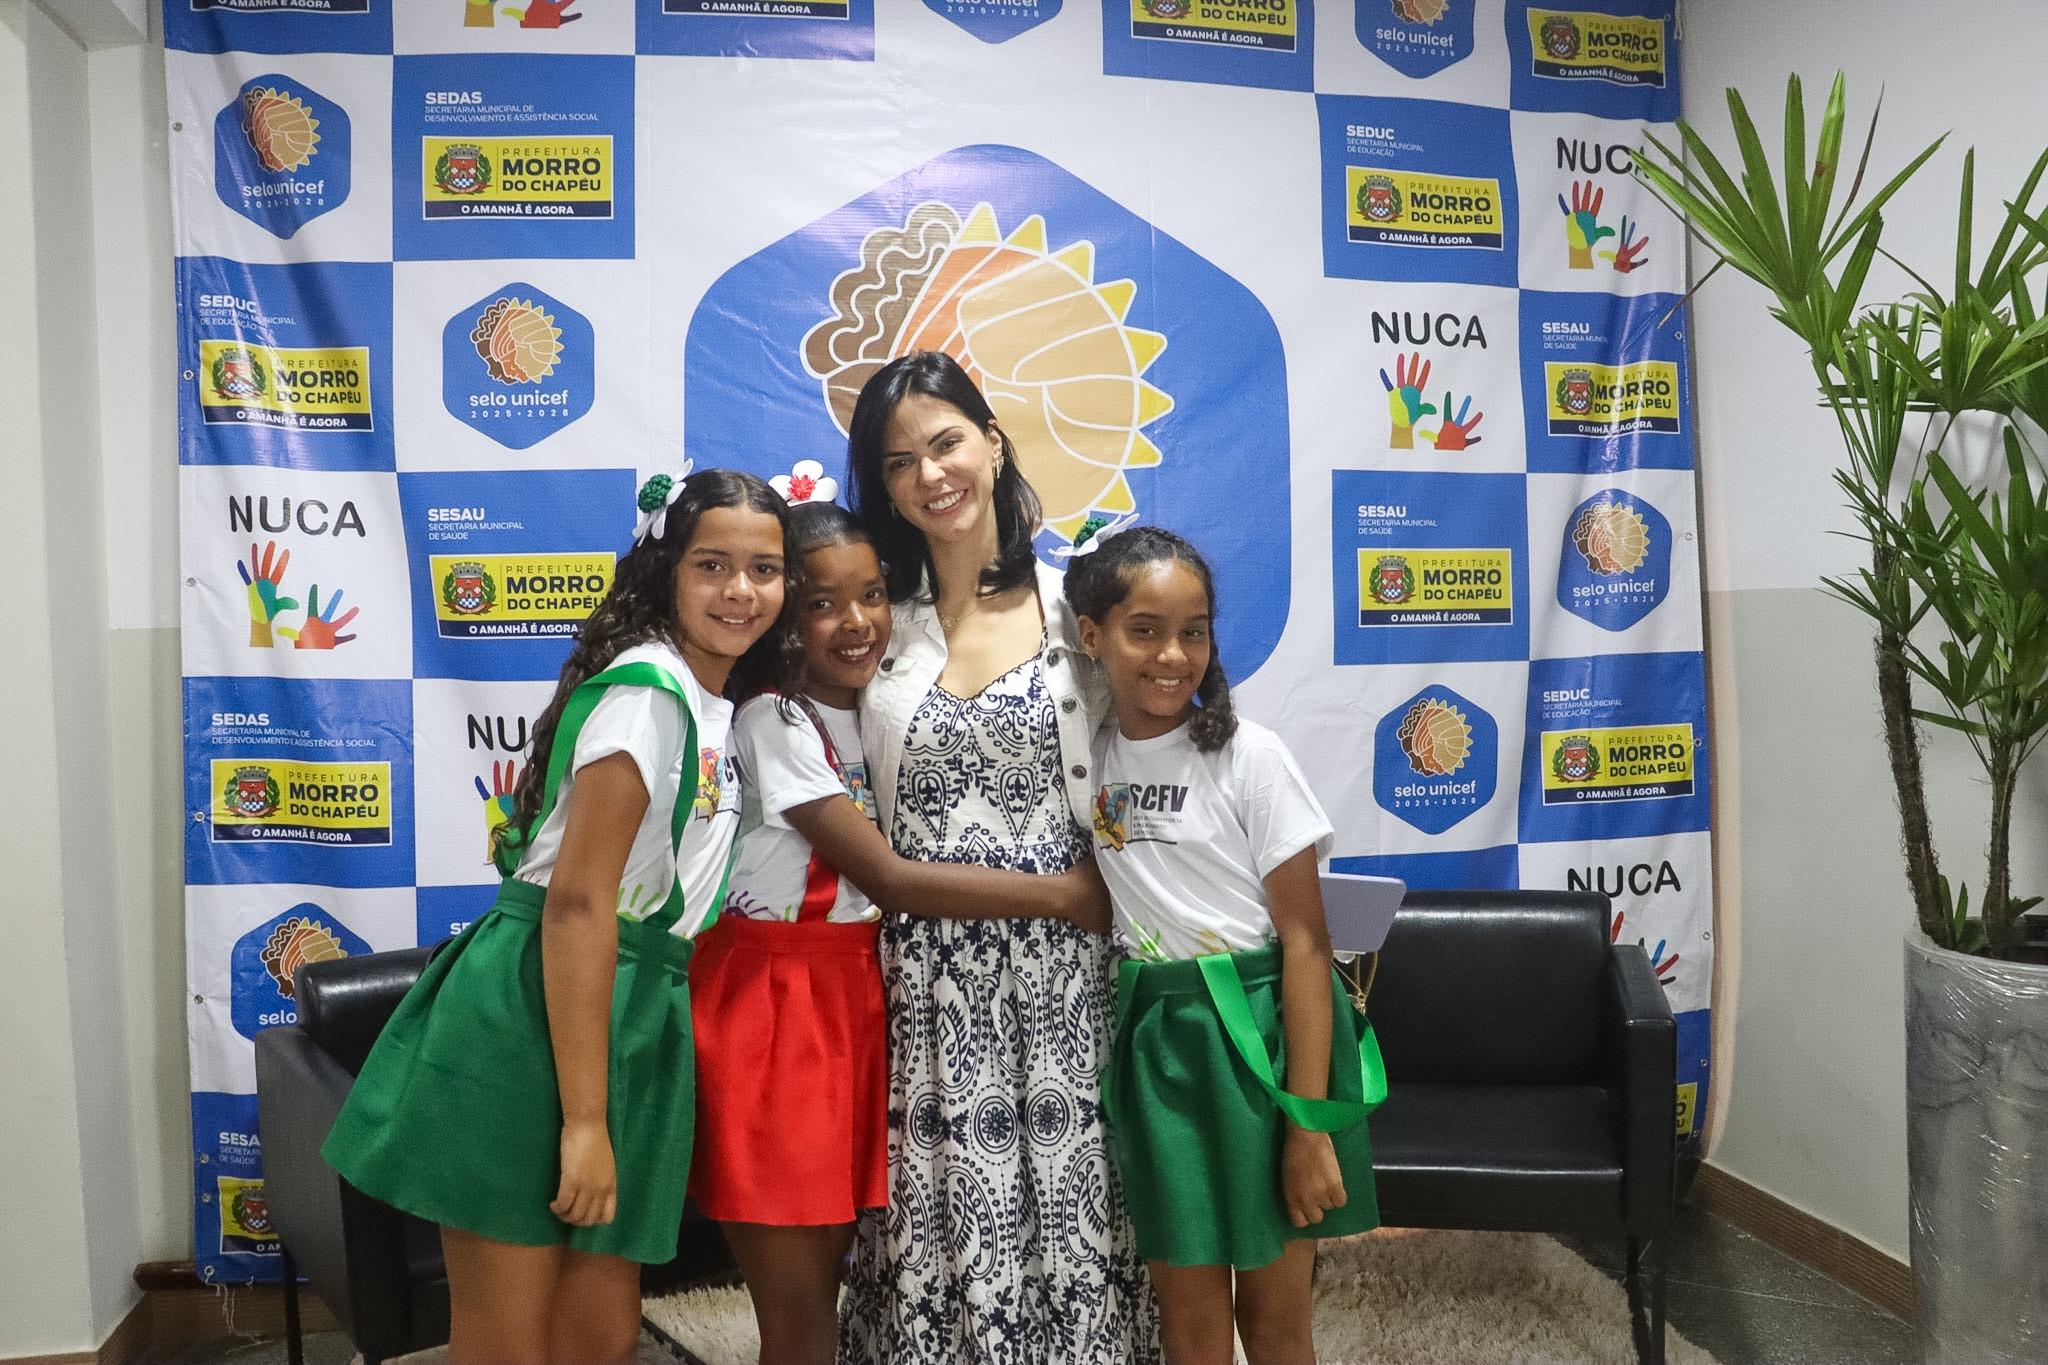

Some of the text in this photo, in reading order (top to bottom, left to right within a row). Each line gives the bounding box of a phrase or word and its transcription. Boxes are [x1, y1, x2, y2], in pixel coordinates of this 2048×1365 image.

[701, 2, 810, 14] O AMANHÃ É AGORA
[1202, 8, 1286, 25] DO CHAPÉU
[1166, 28, 1263, 45] O AMANHÃ É AGORA
[1376, 27, 1453, 47] selo unicef
[1588, 32, 1657, 51] MORRO
[1589, 49, 1608, 58] DO
[425, 91, 482, 104] SEDAS
[425, 114, 506, 122] DESENVOLVIMENTO
[514, 112, 567, 121] ASSISTÊNCIA
[569, 113, 599, 121] SOCIAL
[1346, 125, 1395, 139] SEDUC
[503, 147, 601, 157] PREFEITURA
[1346, 138, 1424, 152] SECRETARIA MUNICIPAL
[503, 158, 601, 176] MORRO
[243, 178, 324, 196] selo unicef
[503, 178, 601, 192] DO CHAPÉU
[1410, 182, 1490, 195] PREFEITURA
[462, 203, 574, 214] O AMANHÃ É AGORA
[1411, 192, 1491, 212] MORRO
[1412, 212, 1492, 224] DO CHAPÉU
[1380, 232, 1472, 245] O AMANHÃ É AGORA
[200, 294, 257, 313] SEDUC
[1371, 310, 1487, 349] NUCA
[1542, 322, 1589, 334] SESAU
[277, 370, 359, 388] MORRO
[277, 390, 361, 404] DO CHAPÉU
[1596, 380, 1670, 400] MORRO
[470, 389, 568, 406] selo unicef
[1594, 403, 1610, 413] DO
[237, 411, 347, 427] O AMANHÃ É AGORA
[1620, 421, 1652, 431] AGORA
[229, 495, 366, 538] NUCA
[428, 508, 485, 521] SESAU
[1358, 505, 1406, 518] SESAU
[428, 522, 524, 531] SECRETARIA MUNICIPAL
[1369, 527, 1392, 535] SAÚDE
[429, 531, 468, 540] DE SAÚDE
[506, 564, 604, 574] PREFEITURA
[1424, 569, 1502, 585] MORRO
[507, 575, 604, 594] MORRO
[1572, 578, 1654, 597] selo unicef
[1424, 588, 1502, 600] DO CHAPÉU
[508, 596, 605, 610] DO CHAPÉU
[1391, 611, 1480, 622] O AMANHÃ É AGORA
[469, 622, 578, 635] O AMANHÃ É AGORA
[1543, 688, 1590, 702] SEDUC
[211, 713, 270, 726] SEDAS
[212, 728, 262, 736] SECRETARIA
[467, 713, 526, 753] NU
[346, 739, 376, 747] SOCIAL
[1609, 734, 1682, 745] PREFEITURA
[1609, 743, 1685, 763] MORRO
[1610, 761, 1686, 777] DO CHAPÉU
[288, 771, 379, 782] PREFEITURA
[289, 782, 378, 802] MORRO
[1394, 780, 1476, 797] selo unicef
[1577, 787, 1666, 799] O AMANHÃ É AGORA
[1130, 784, 1188, 812] SCFV
[290, 804, 379, 818] DO CHAPÉU
[252, 828, 352, 842] O AMANHÃ É AGORA
[1567, 860, 1682, 899] NUCA
[258, 1009, 298, 1026] selo
[219, 1132, 261, 1146] SESA
